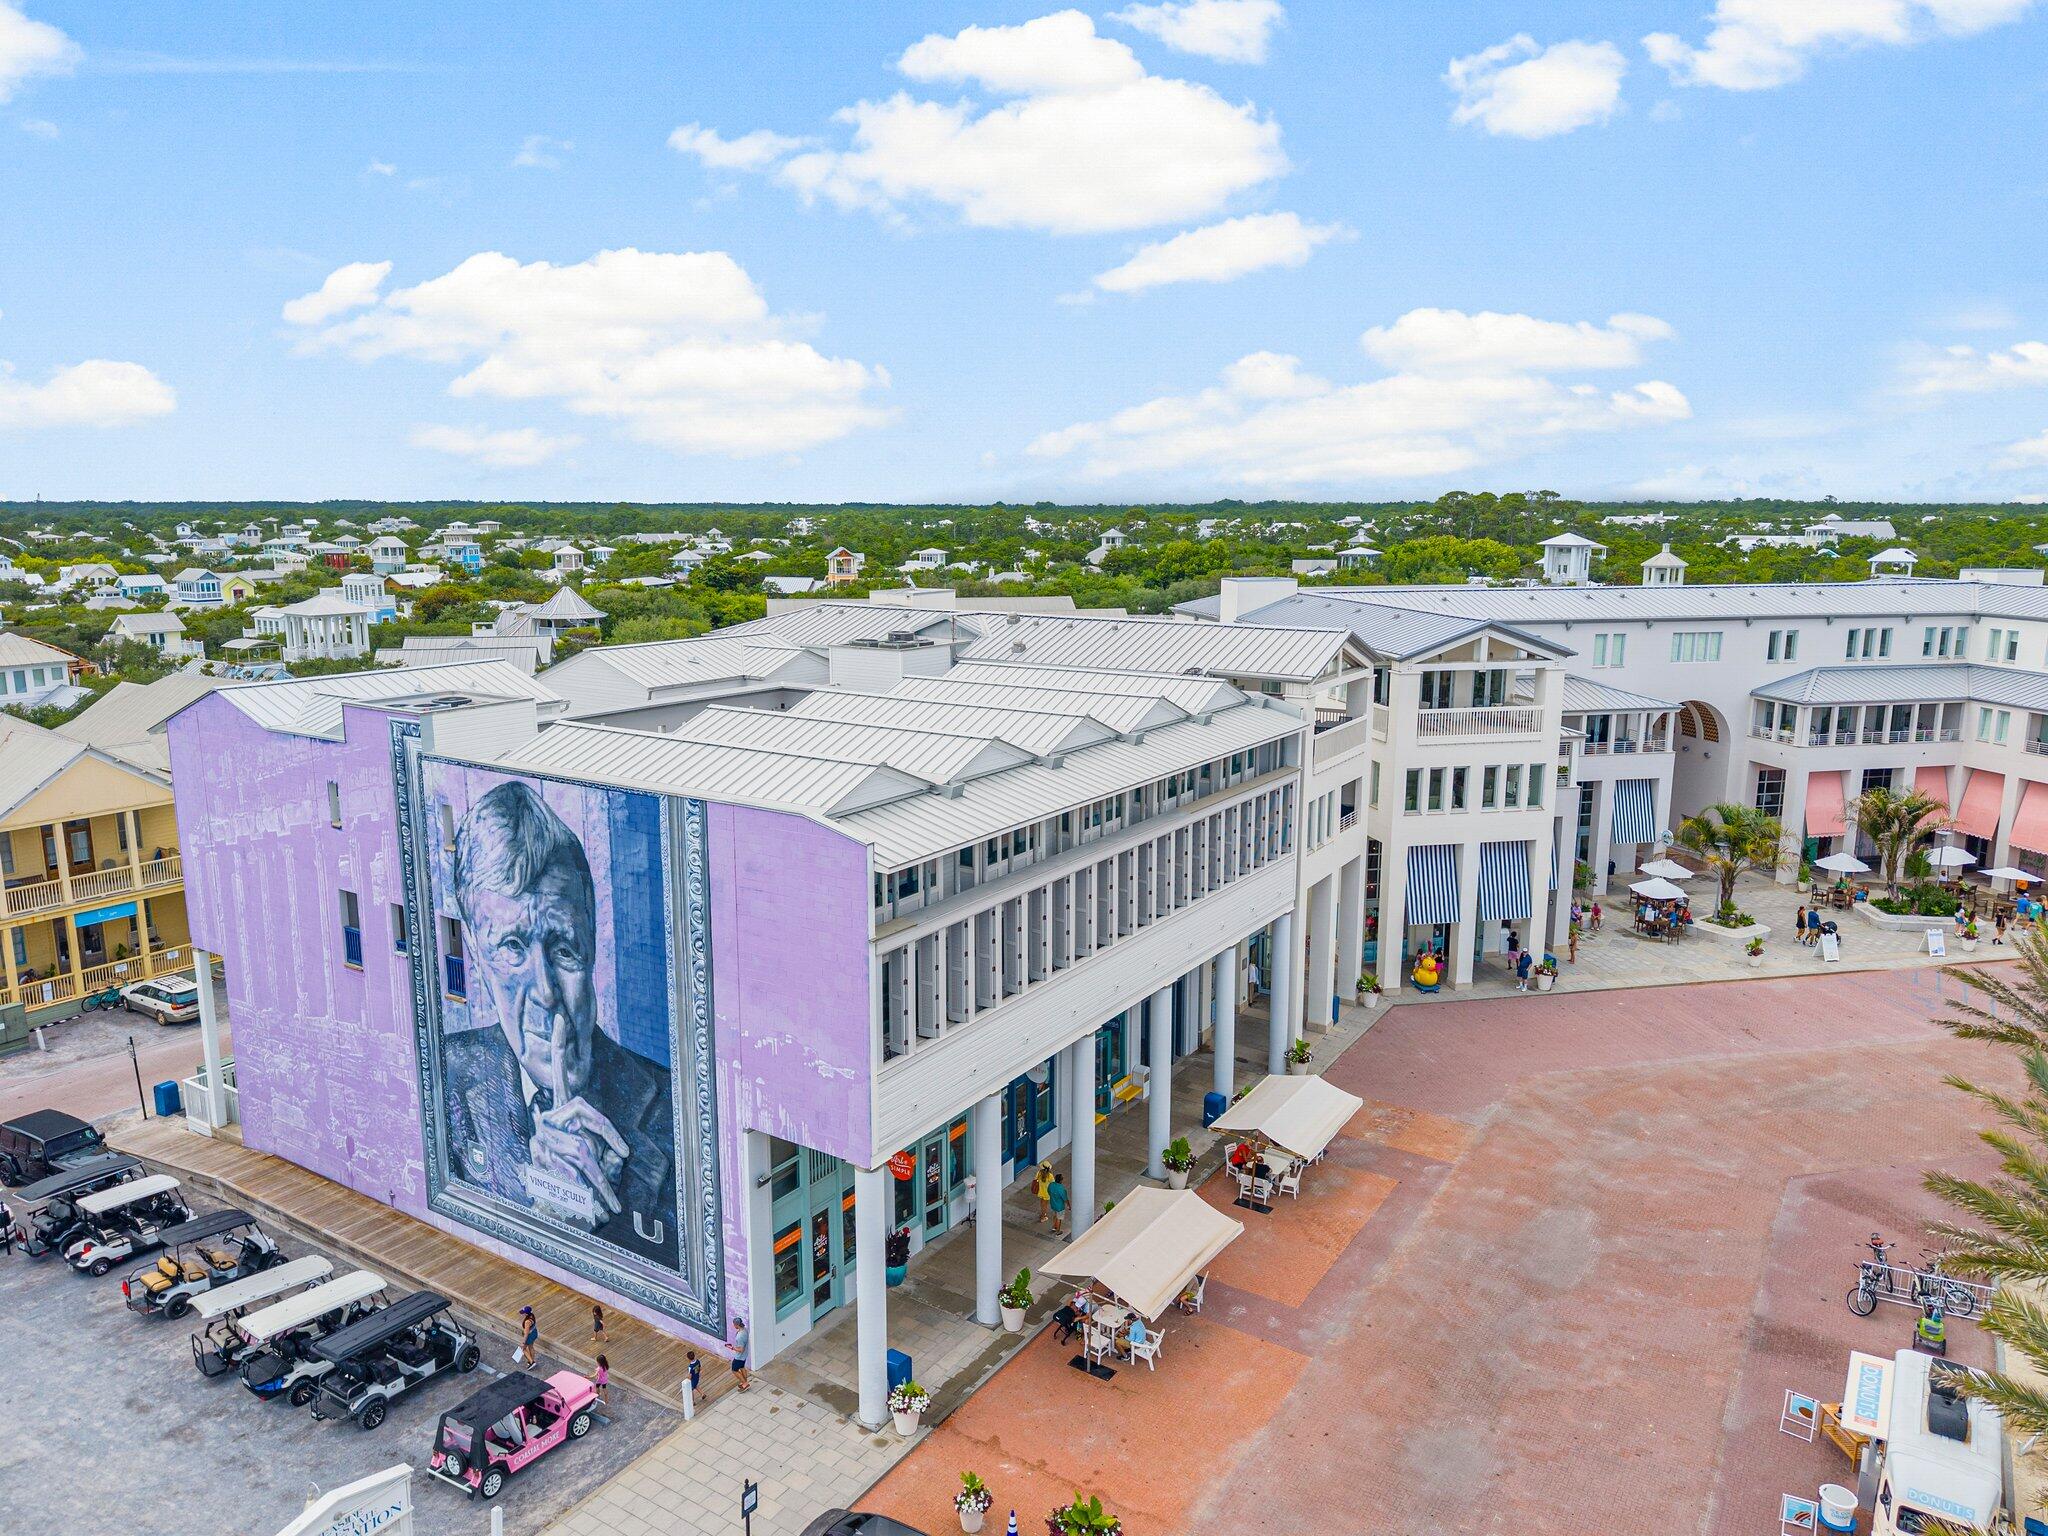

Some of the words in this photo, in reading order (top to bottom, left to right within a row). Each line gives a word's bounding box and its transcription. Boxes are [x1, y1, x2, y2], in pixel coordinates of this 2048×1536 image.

[889, 1165, 911, 1177] SIMPLE
[529, 1175, 561, 1194] VINCENT
[561, 1188, 587, 1205] SCULLY
[1857, 1365, 1880, 1418] DONUTS
[513, 1443, 541, 1465] COASTAL
[541, 1431, 560, 1448] MOKE
[354, 1501, 402, 1536] ATION
[1908, 1489, 1975, 1518] DONUTS
